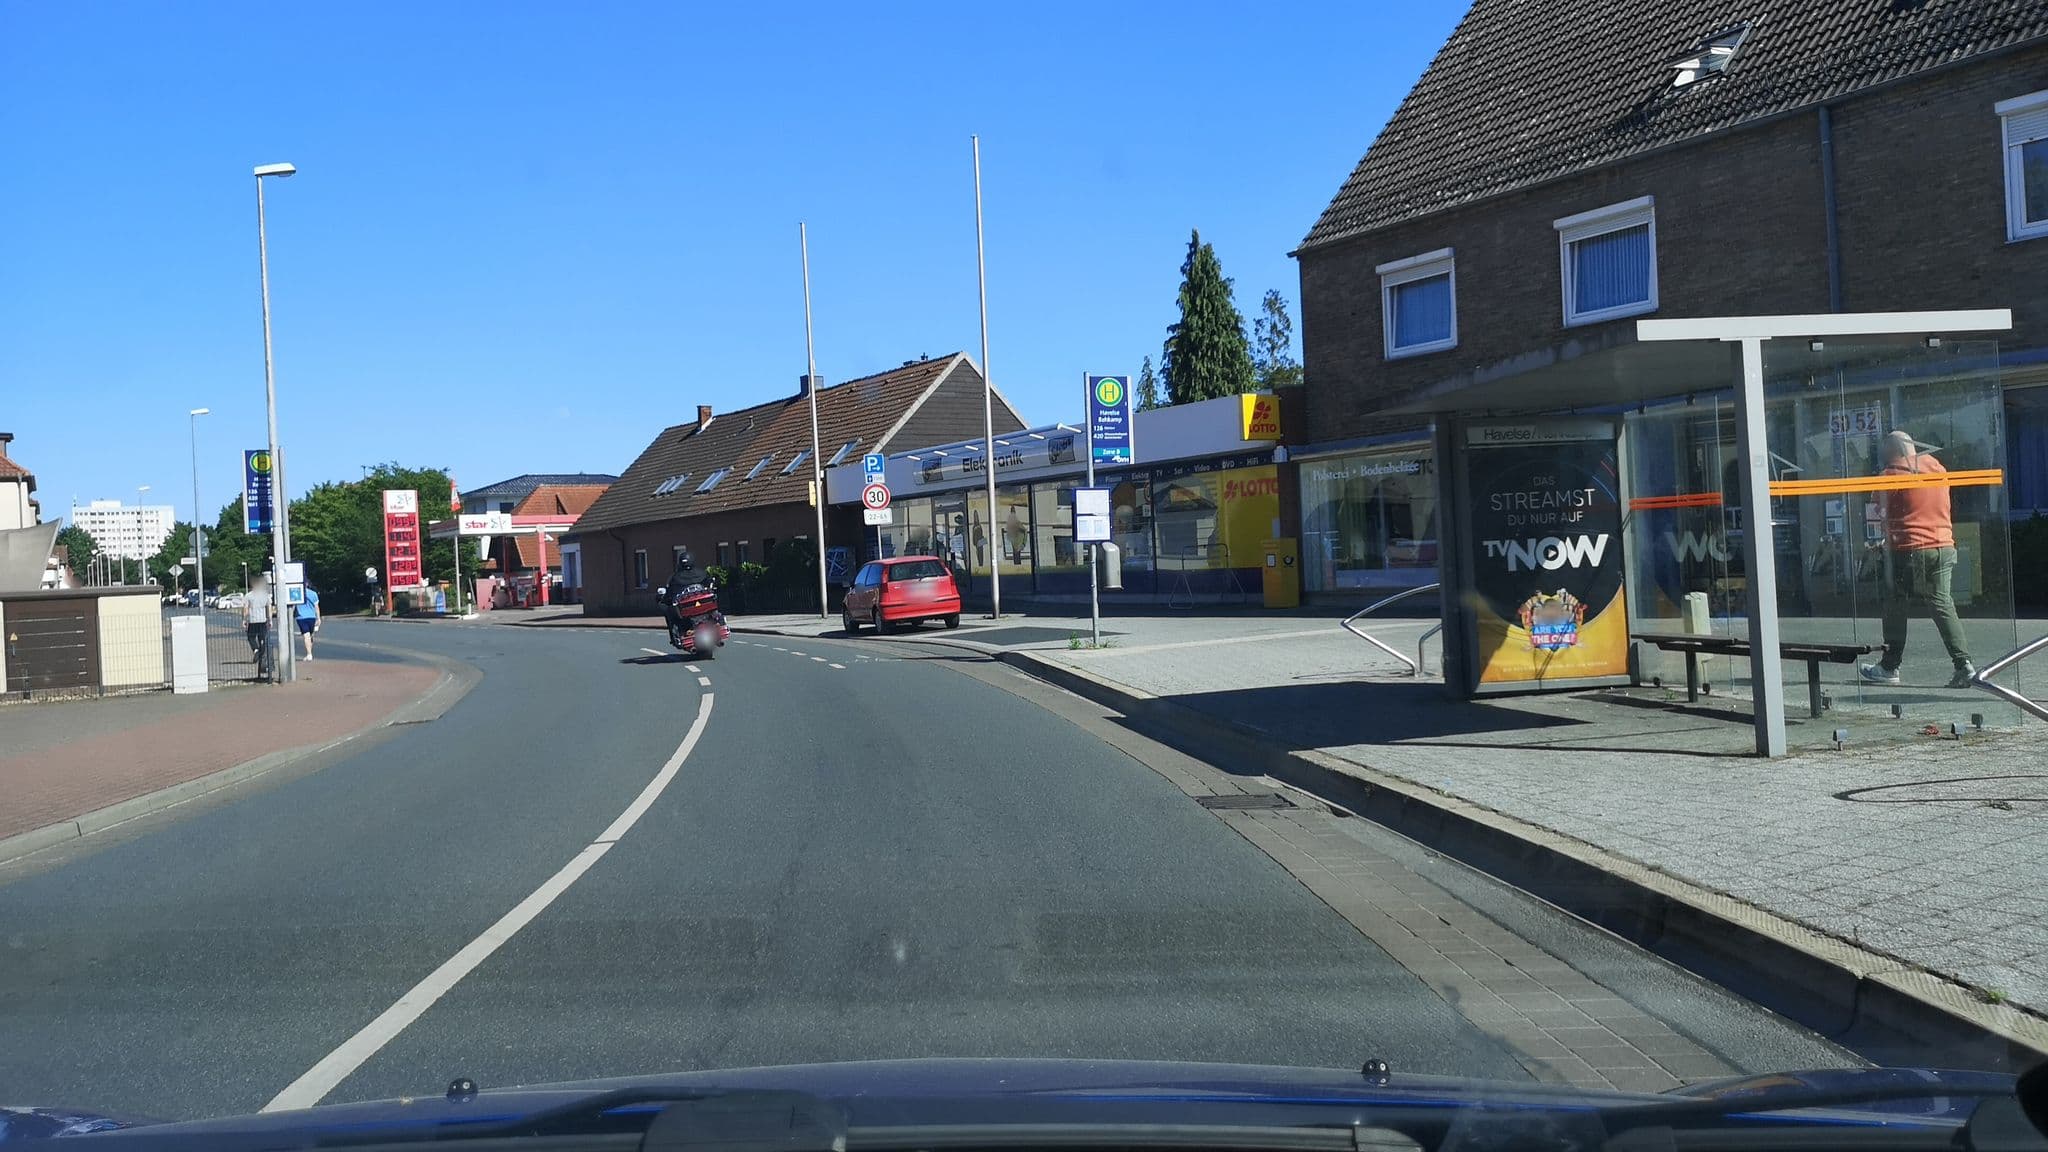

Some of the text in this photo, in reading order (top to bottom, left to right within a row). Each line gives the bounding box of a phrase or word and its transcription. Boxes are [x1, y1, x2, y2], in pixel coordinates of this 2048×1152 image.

[1249, 423, 1277, 433] LOTTO
[1855, 412, 1876, 432] 52
[867, 456, 878, 472] P
[962, 450, 1024, 473] Elekronik
[1156, 469, 1163, 477] TV
[1194, 464, 1211, 473] Video
[1533, 476, 1556, 486] DAS
[869, 490, 884, 503] 30
[1490, 488, 1596, 511] STREAMST
[465, 520, 488, 529] star
[1507, 511, 1584, 526] DU NUR AUF
[1534, 625, 1551, 634] ARE
[1532, 634, 1550, 644] THE
